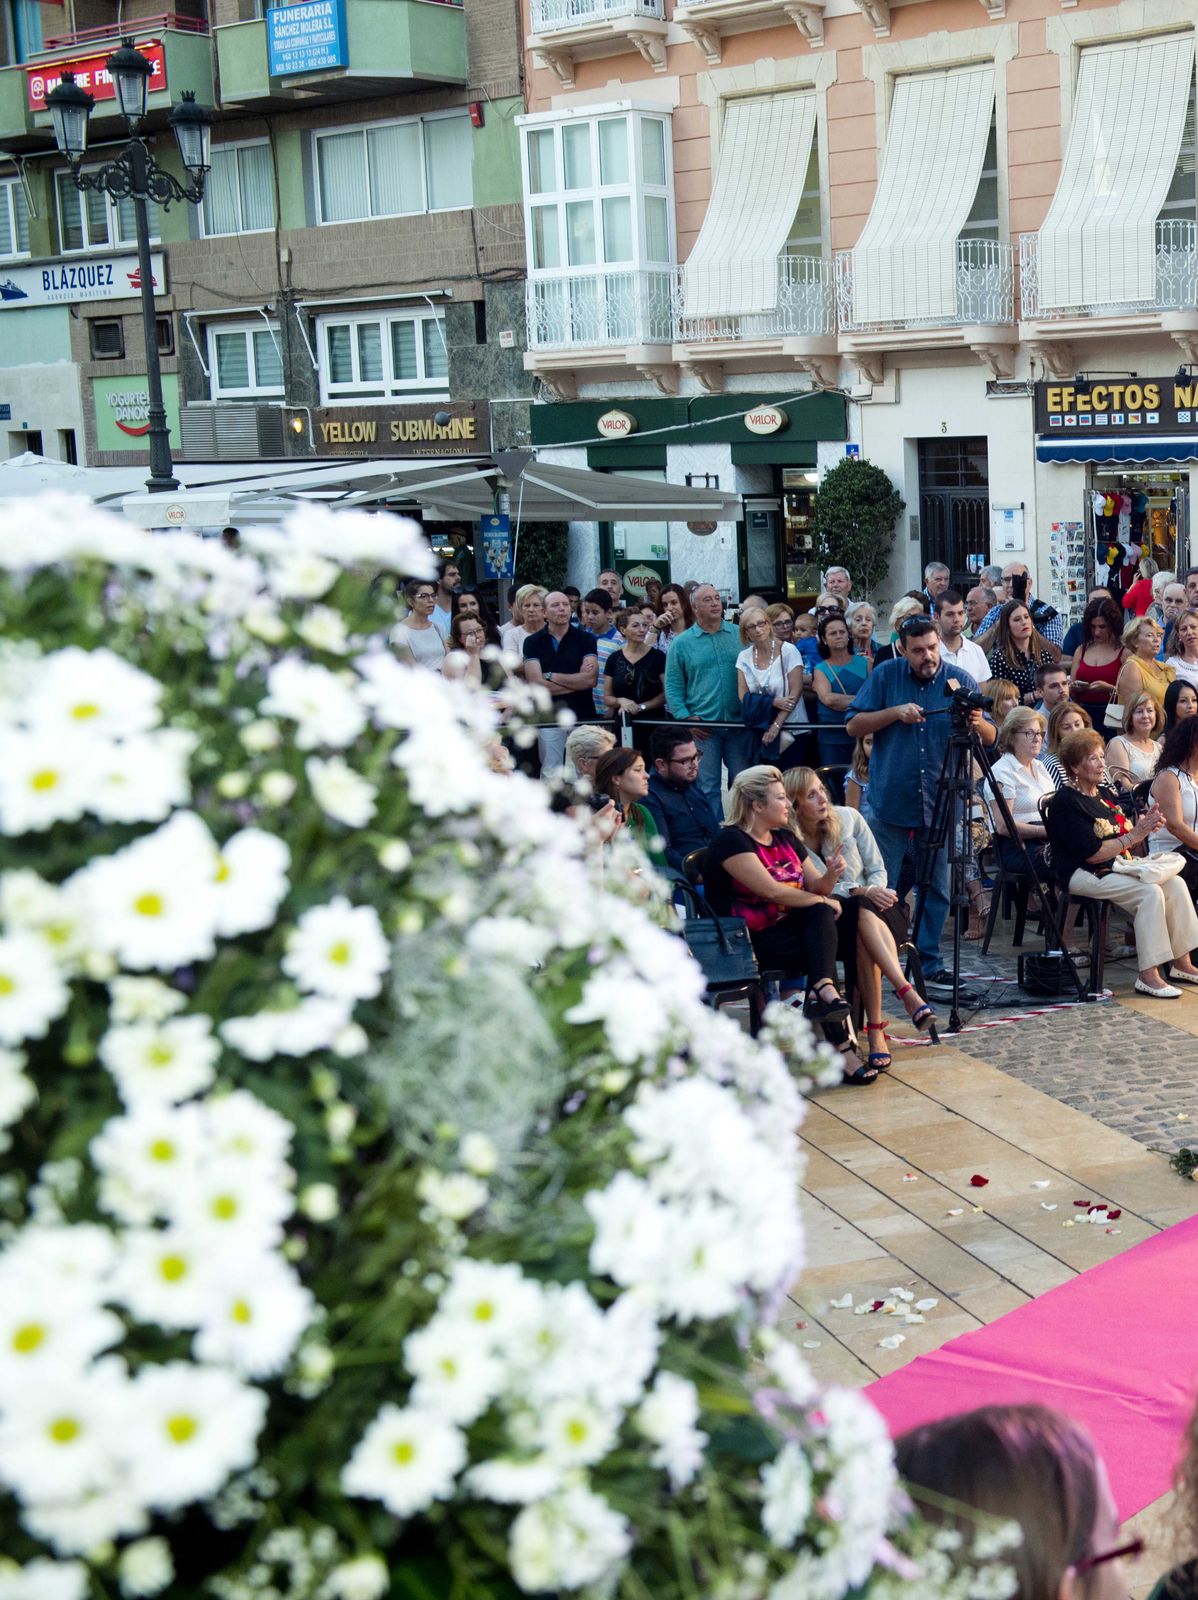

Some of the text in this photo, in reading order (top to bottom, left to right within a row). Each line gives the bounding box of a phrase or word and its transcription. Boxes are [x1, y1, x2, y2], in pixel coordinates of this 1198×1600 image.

[273, 2, 333, 25] FUNERARIA
[274, 23, 300, 38] SÁNCHEZ
[300, 19, 322, 34] MOLERA
[42, 264, 114, 291] BLÁZQUEZ
[1047, 383, 1160, 412] EFECTOS
[115, 406, 150, 421] DANON
[749, 414, 778, 425] VALOR
[320, 417, 475, 443] YELLOW SUBMARINE
[601, 419, 628, 430] VALOR
[941, 422, 948, 433] 3
